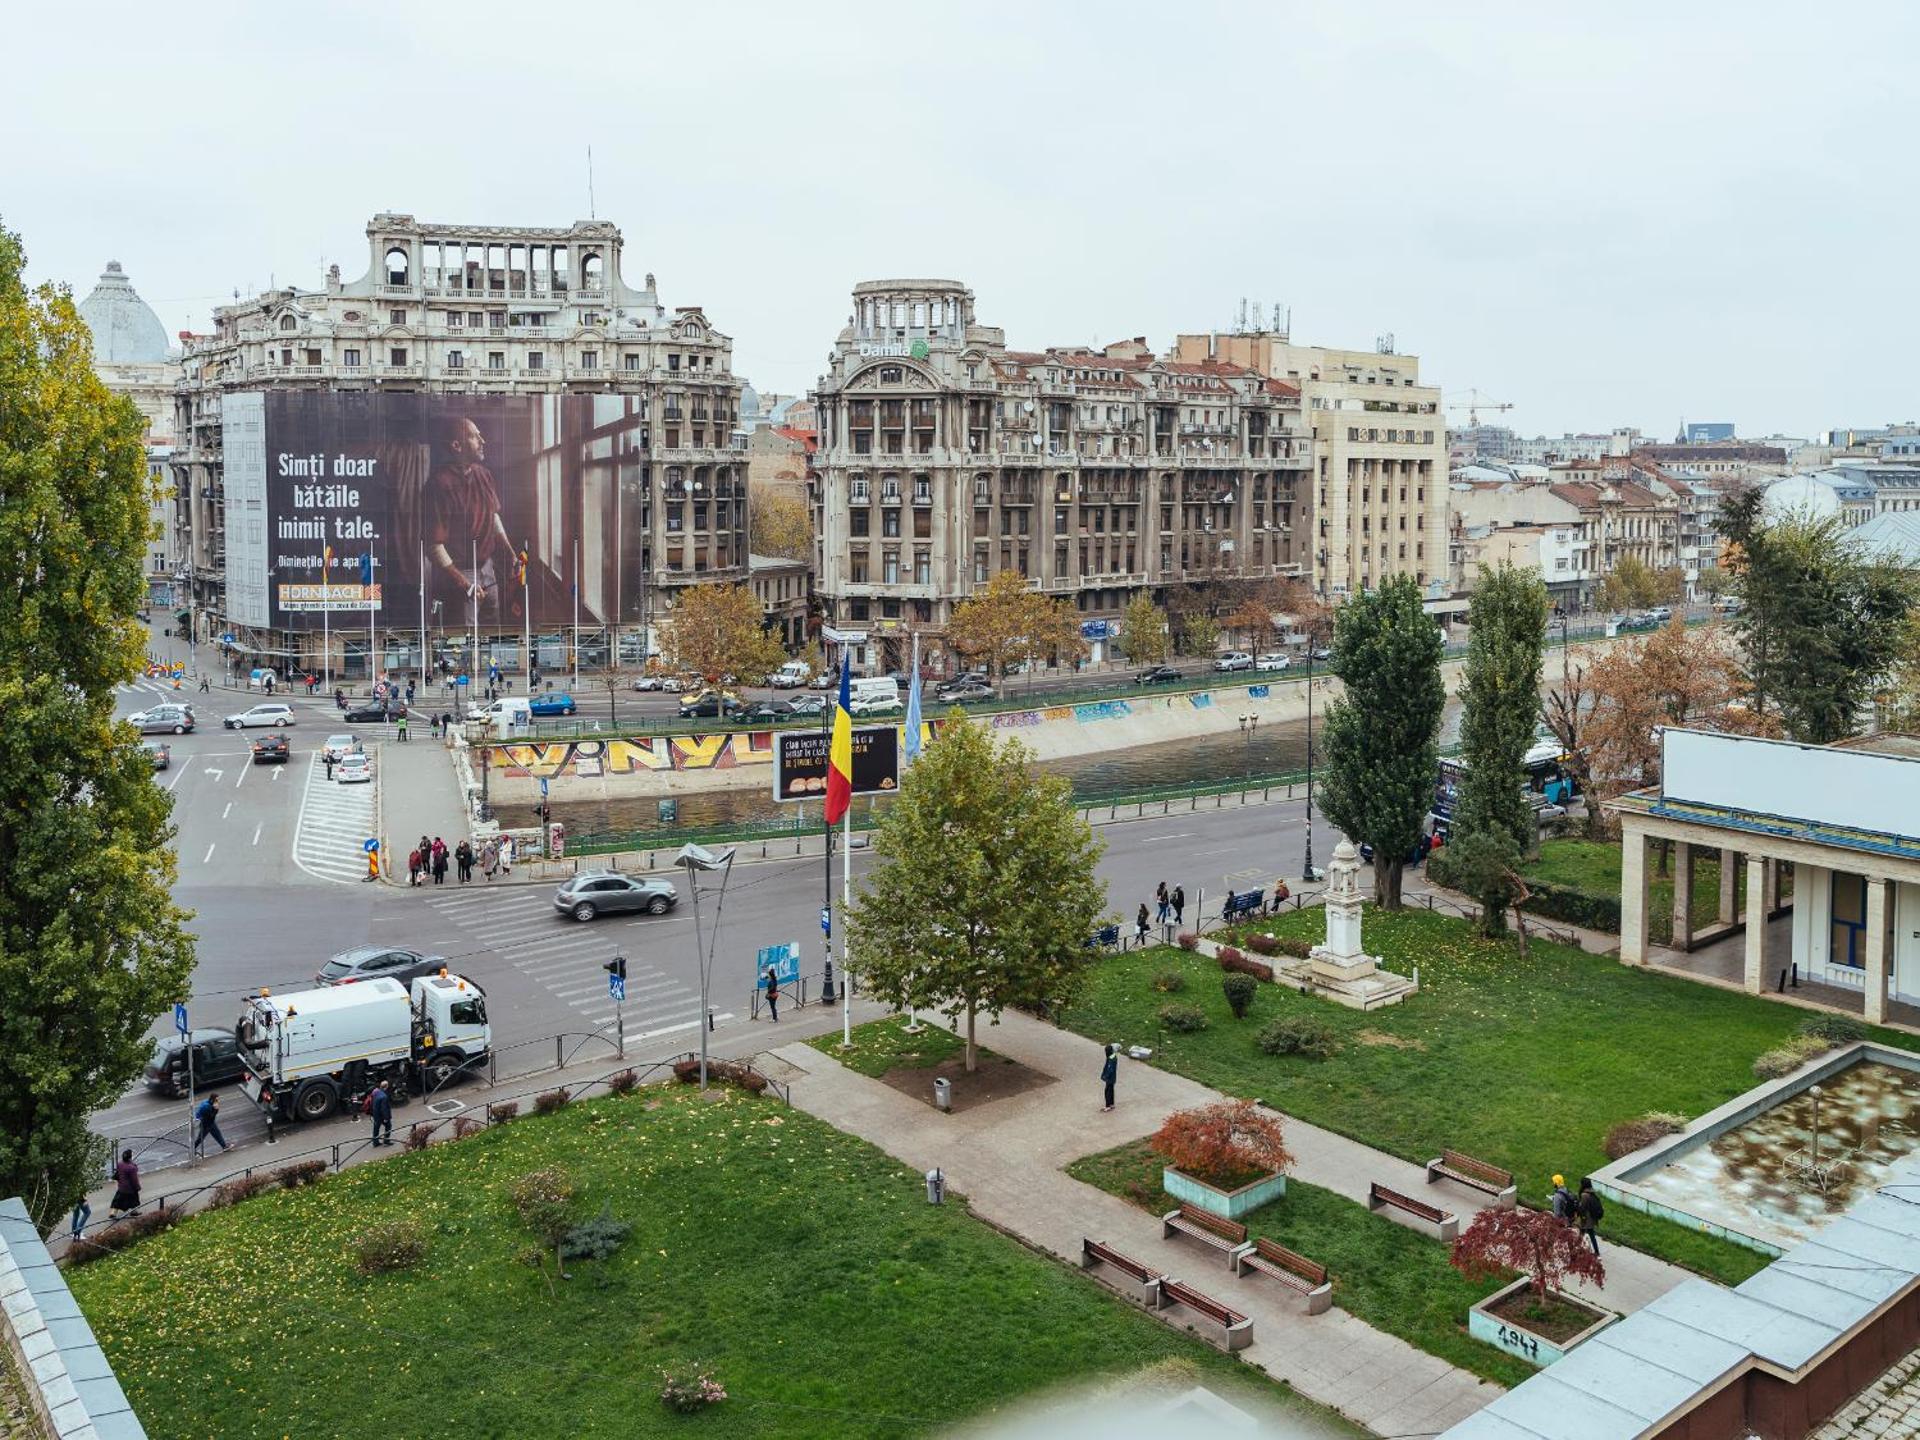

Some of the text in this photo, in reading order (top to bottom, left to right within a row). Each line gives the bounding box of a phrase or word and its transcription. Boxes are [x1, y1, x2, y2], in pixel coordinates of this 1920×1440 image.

[278, 453, 377, 483] Simți doar
[294, 484, 359, 508] bătăile
[278, 515, 379, 539] inimii tale.
[281, 587, 362, 599] HORNBACH
